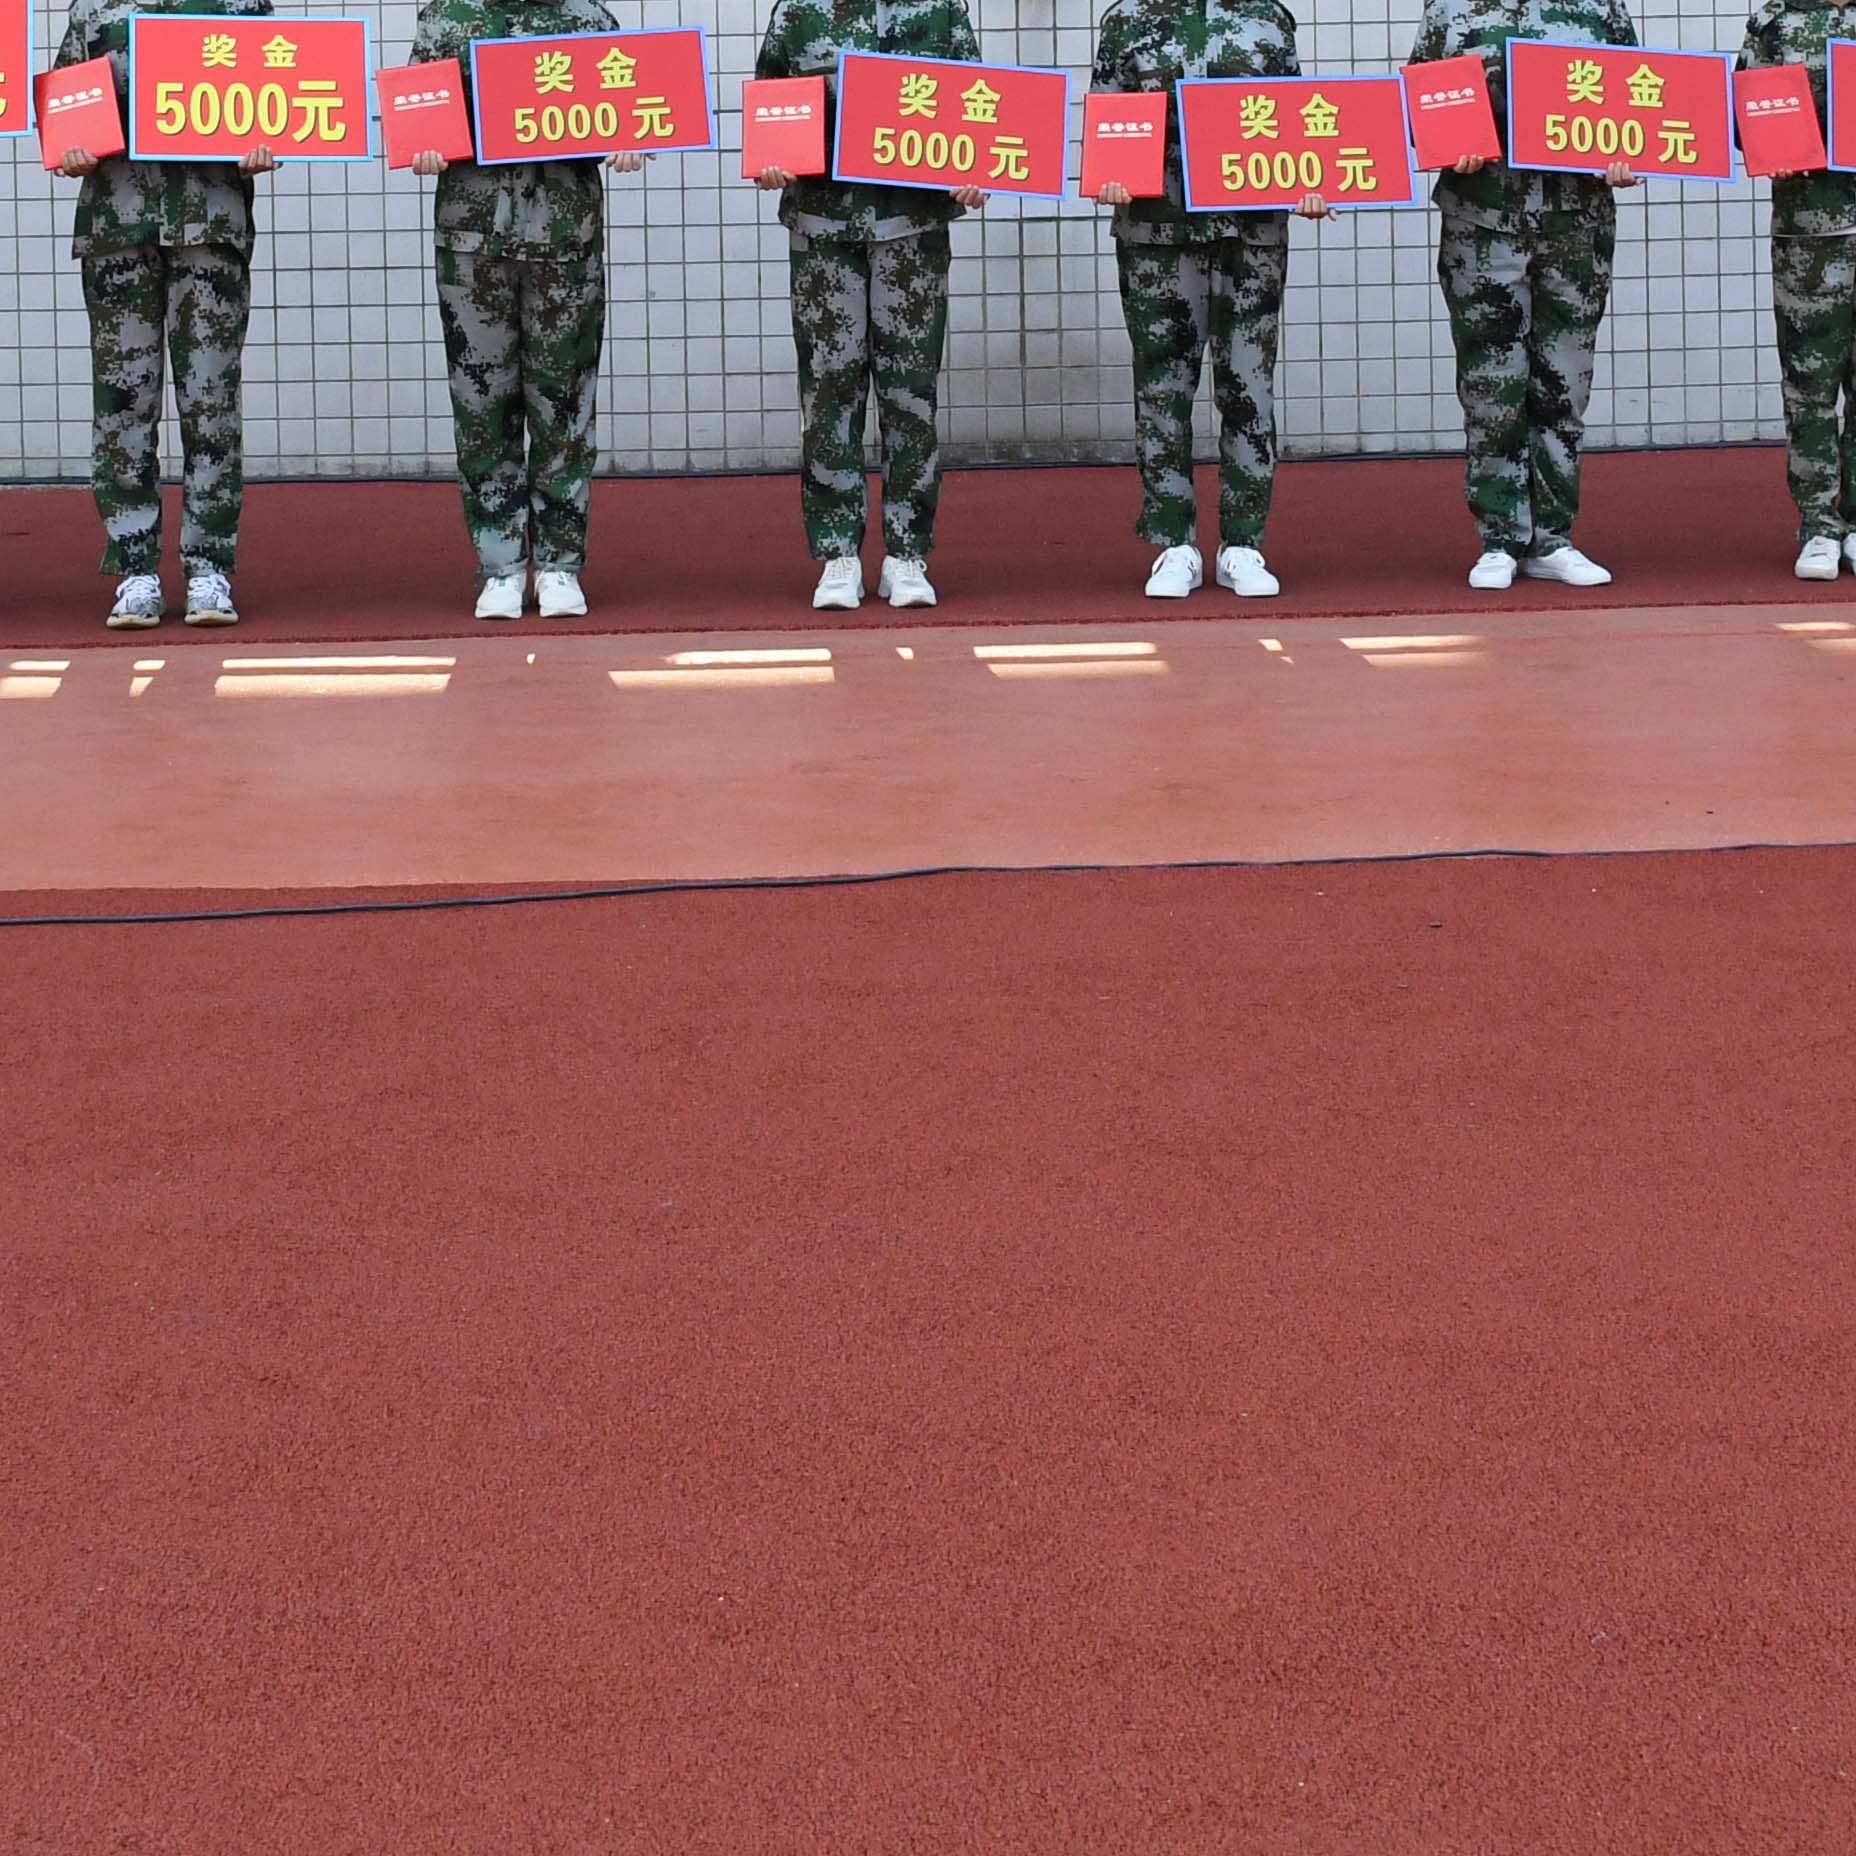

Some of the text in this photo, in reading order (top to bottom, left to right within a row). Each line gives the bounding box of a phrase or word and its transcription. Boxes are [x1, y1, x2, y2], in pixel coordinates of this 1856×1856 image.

[203, 35, 296, 68] 奖金
[536, 48, 636, 94] 奖金
[901, 75, 1000, 123] 奖金
[1568, 60, 1665, 108] 奖金
[156, 80, 346, 142] 5000元
[514, 96, 674, 143] 5000元
[1241, 94, 1339, 139] 奖金
[873, 127, 1029, 180] 5000元
[1546, 114, 1697, 164] 5000元
[1222, 148, 1377, 191] 5000元
